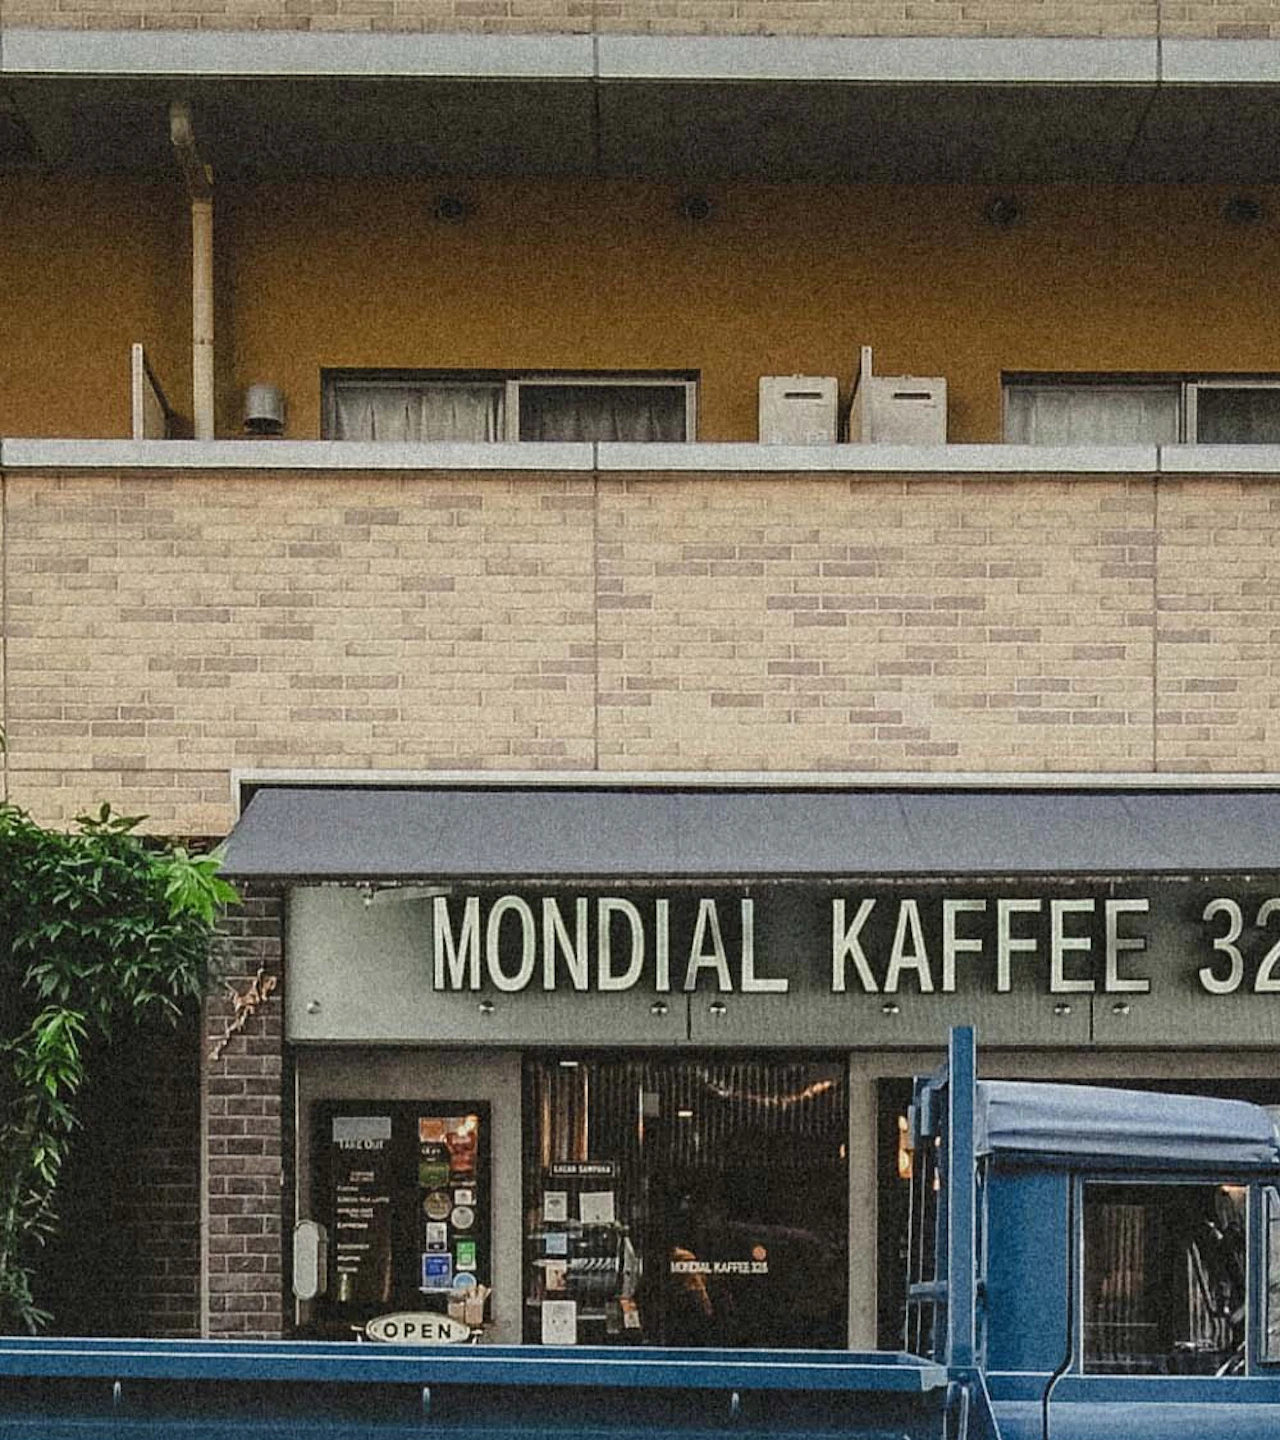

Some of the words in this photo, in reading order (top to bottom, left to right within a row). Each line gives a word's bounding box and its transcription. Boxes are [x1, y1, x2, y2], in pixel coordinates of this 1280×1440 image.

[433, 896, 789, 991] MONDIAL
[831, 899, 1151, 992] KAFFEE
[714, 1261, 749, 1274] KAFFEE
[383, 1322, 451, 1339] OPEN
